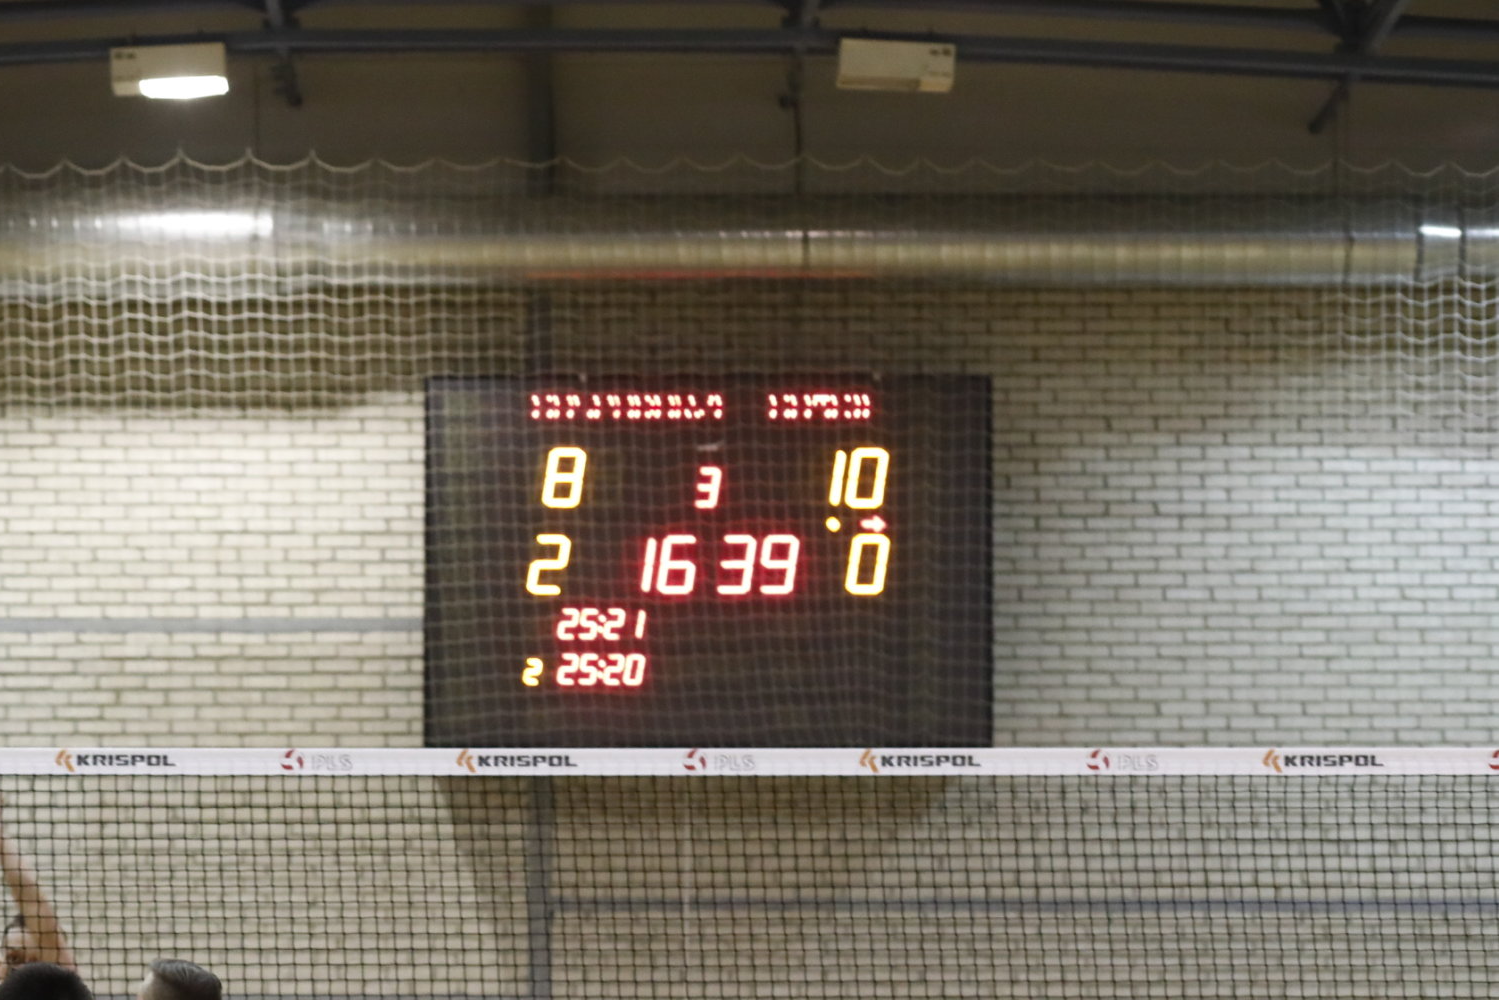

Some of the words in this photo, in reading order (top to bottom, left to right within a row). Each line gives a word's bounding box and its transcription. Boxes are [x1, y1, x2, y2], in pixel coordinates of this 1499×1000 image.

[541, 446, 587, 509] 8
[694, 466, 722, 509] 3
[828, 446, 890, 510] 10
[526, 533, 572, 596] 2
[844, 532, 892, 596] 0
[555, 607, 647, 641] 25:21
[522, 656, 544, 687] 2
[555, 652, 647, 687] 25:20
[76, 753, 177, 767] KRISPOL
[477, 754, 578, 768] KRISPOL
[881, 754, 981, 767] KRISPOL
[1283, 754, 1385, 767] KRISPOL
